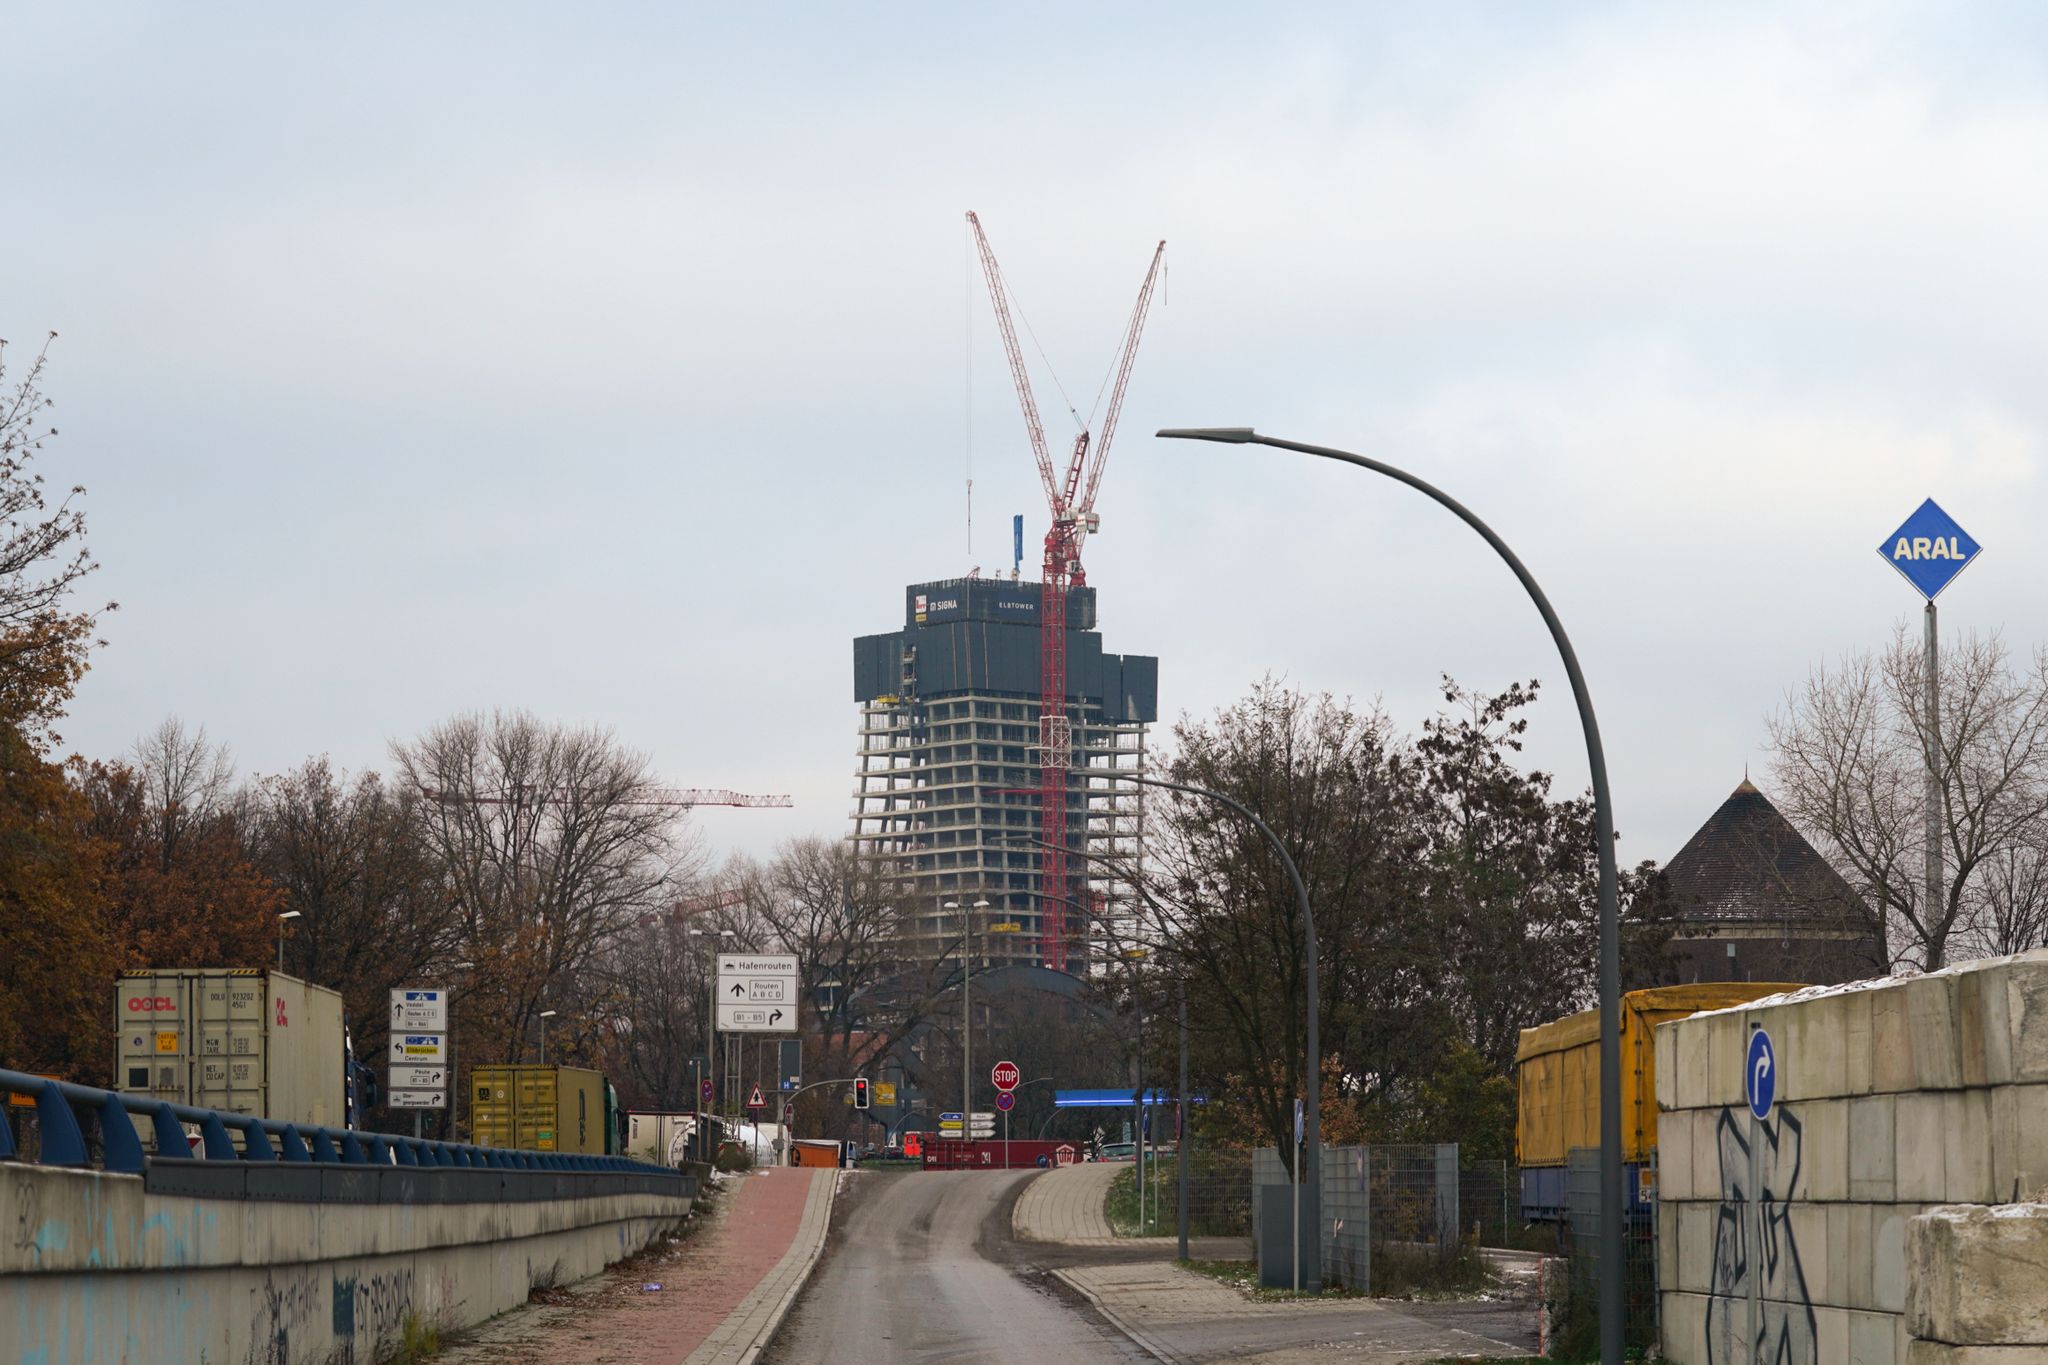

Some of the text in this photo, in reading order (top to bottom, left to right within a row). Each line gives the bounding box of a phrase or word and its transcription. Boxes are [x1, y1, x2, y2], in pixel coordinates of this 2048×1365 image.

[1893, 536, 1966, 560] ARAL
[937, 600, 958, 611] SIGNA
[999, 602, 1034, 610] ELBTOWER
[739, 961, 792, 970] Hafenrouten
[128, 997, 176, 1011] OOCL
[995, 1070, 1017, 1082] STOP
